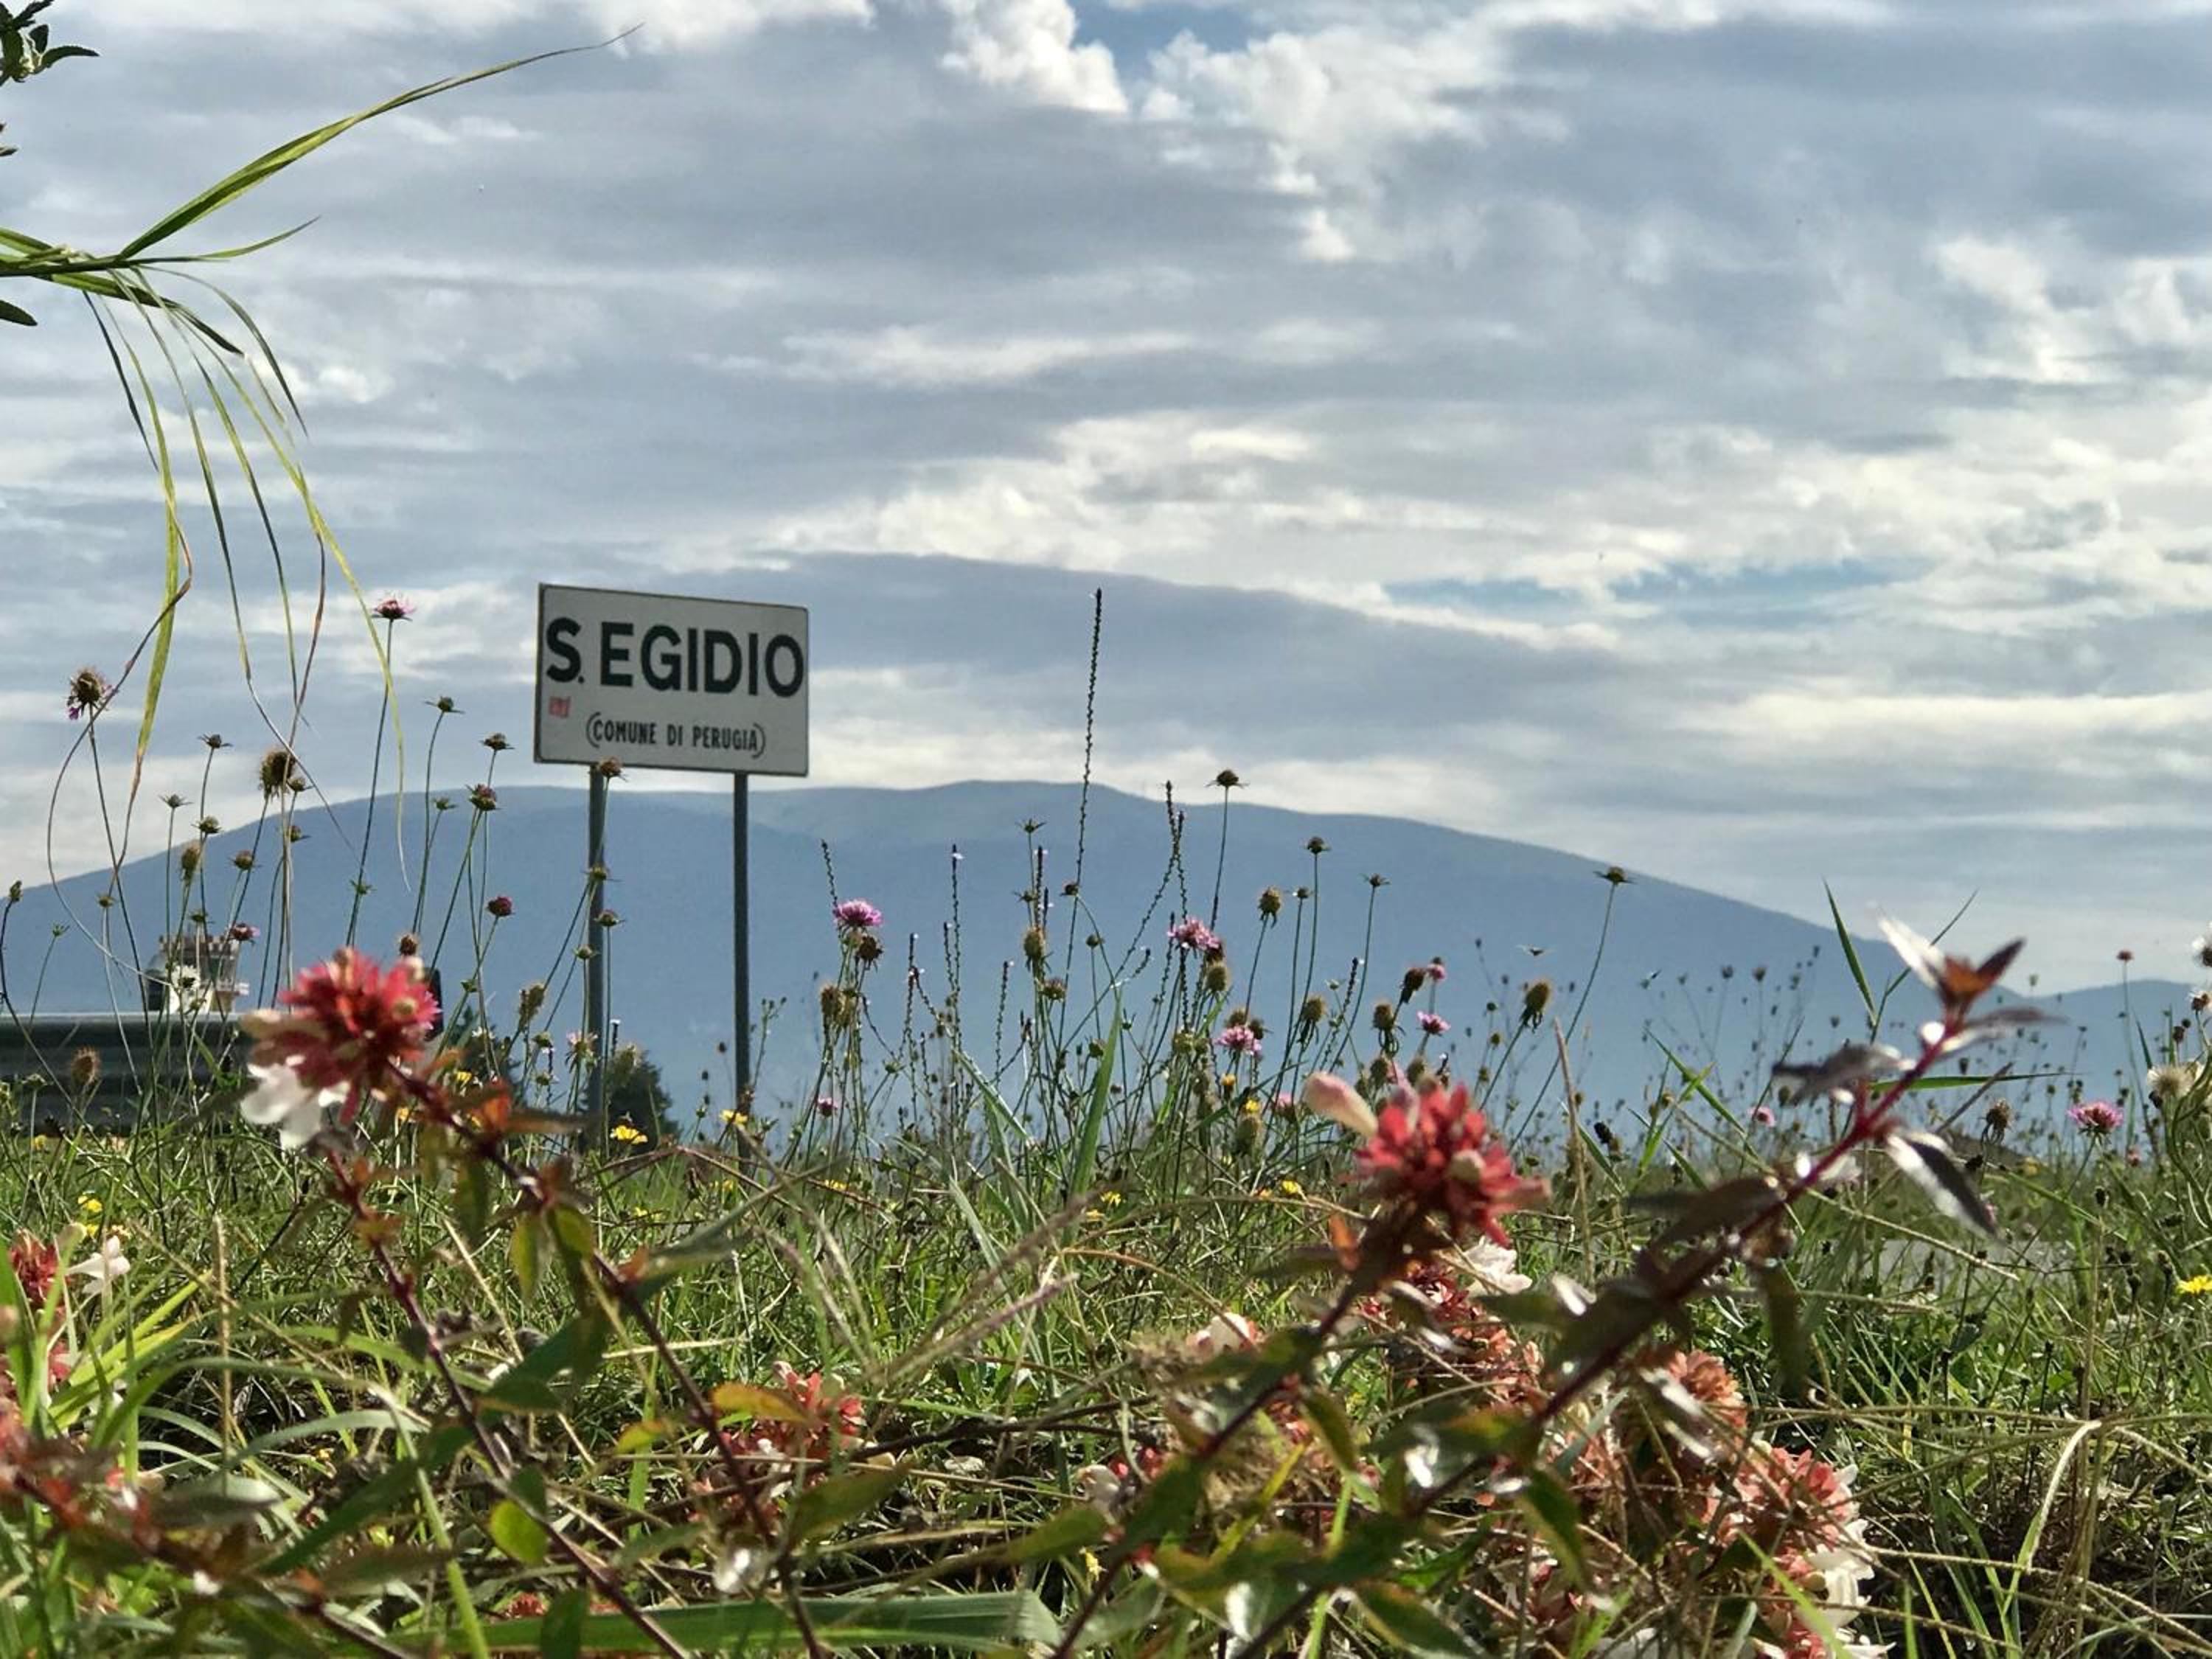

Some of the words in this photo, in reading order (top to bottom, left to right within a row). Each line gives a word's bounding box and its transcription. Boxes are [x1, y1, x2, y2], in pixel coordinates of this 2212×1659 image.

[546, 616, 585, 684] S.
[600, 621, 804, 698] EGIDIO
[586, 712, 657, 748] (COMUNE
[667, 723, 684, 747] DI
[692, 723, 766, 759] PERUGIA)
